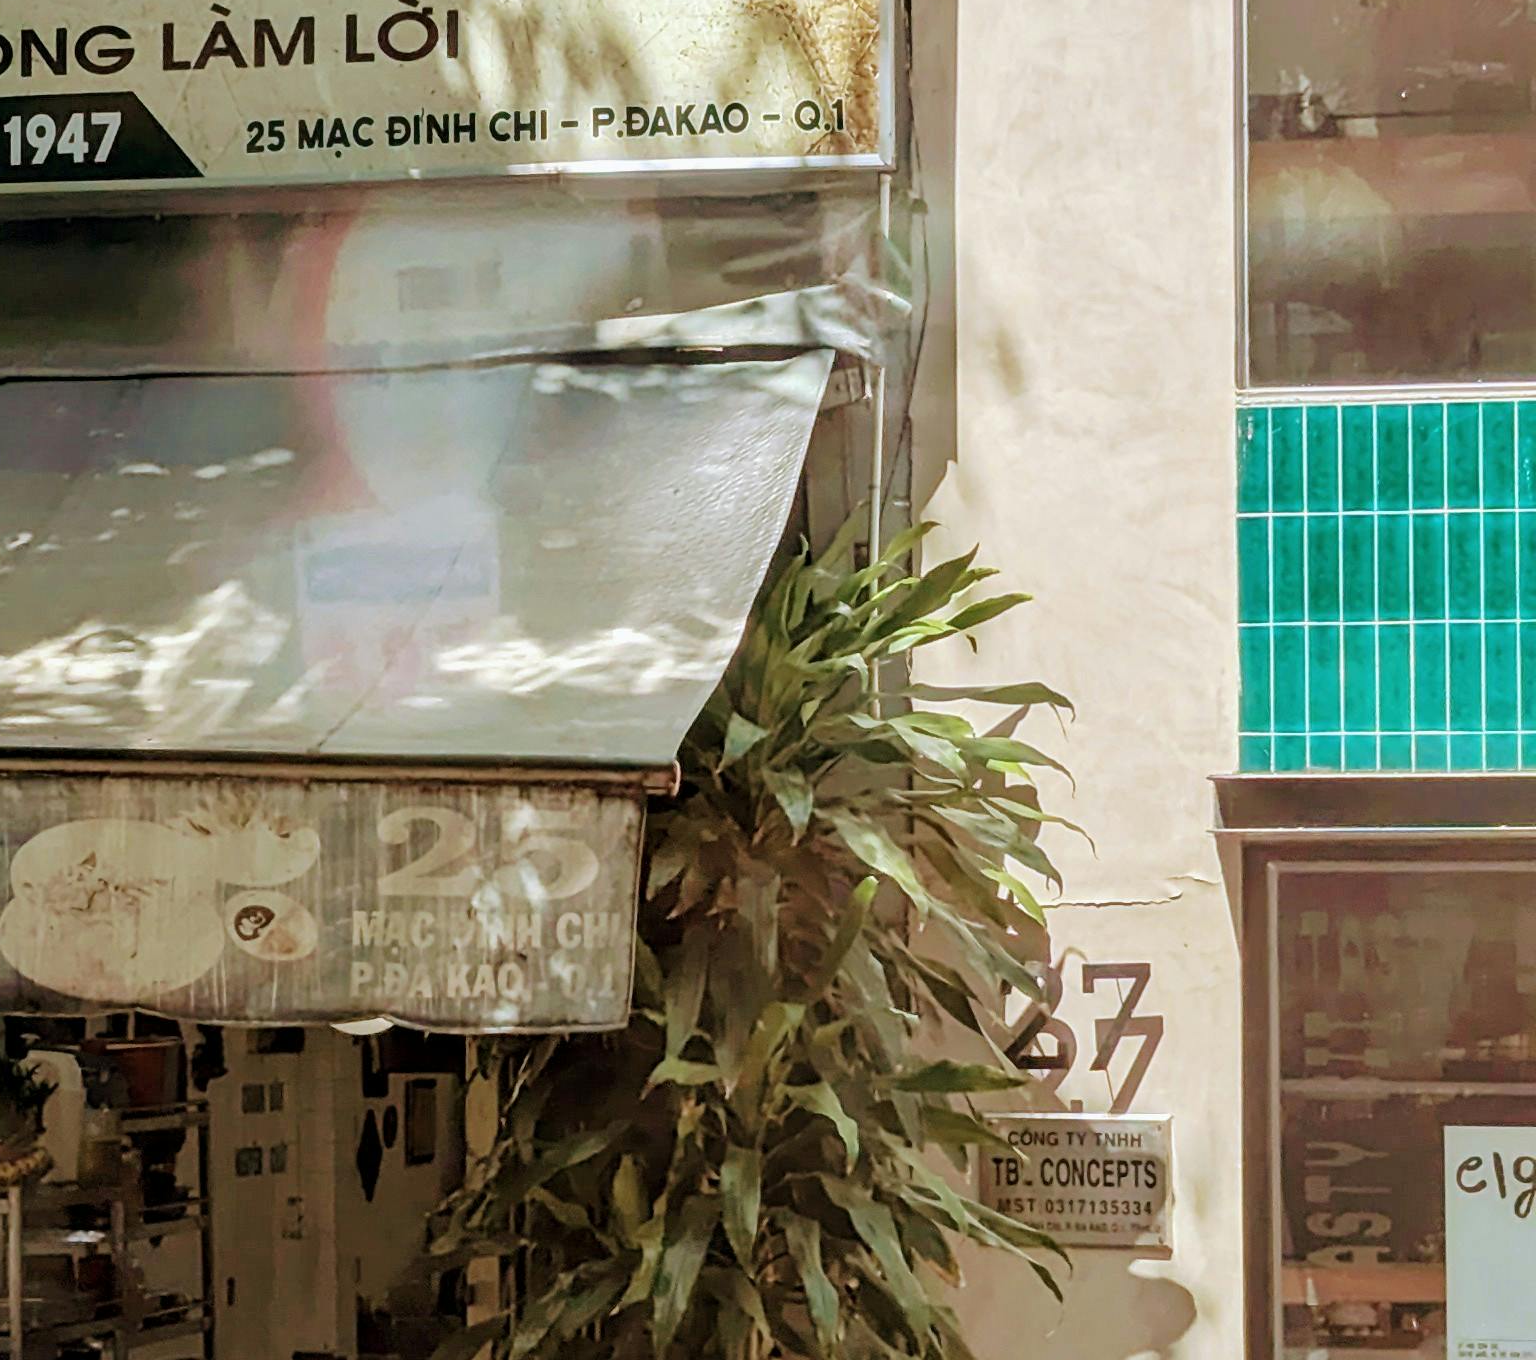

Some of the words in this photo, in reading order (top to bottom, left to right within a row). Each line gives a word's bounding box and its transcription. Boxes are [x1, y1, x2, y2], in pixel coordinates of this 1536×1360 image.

[161, 3, 316, 71] LÀM
[3, 111, 122, 164] 1947
[246, 120, 286, 154] 25
[296, 115, 375, 159] MẠC
[488, 109, 550, 142] CHI
[793, 98, 847, 132] Q.1
[1066, 1131, 1088, 1146] TY
[1095, 1132, 1143, 1148] TNHH
[1040, 1156, 1158, 1189] CONCEPTS
